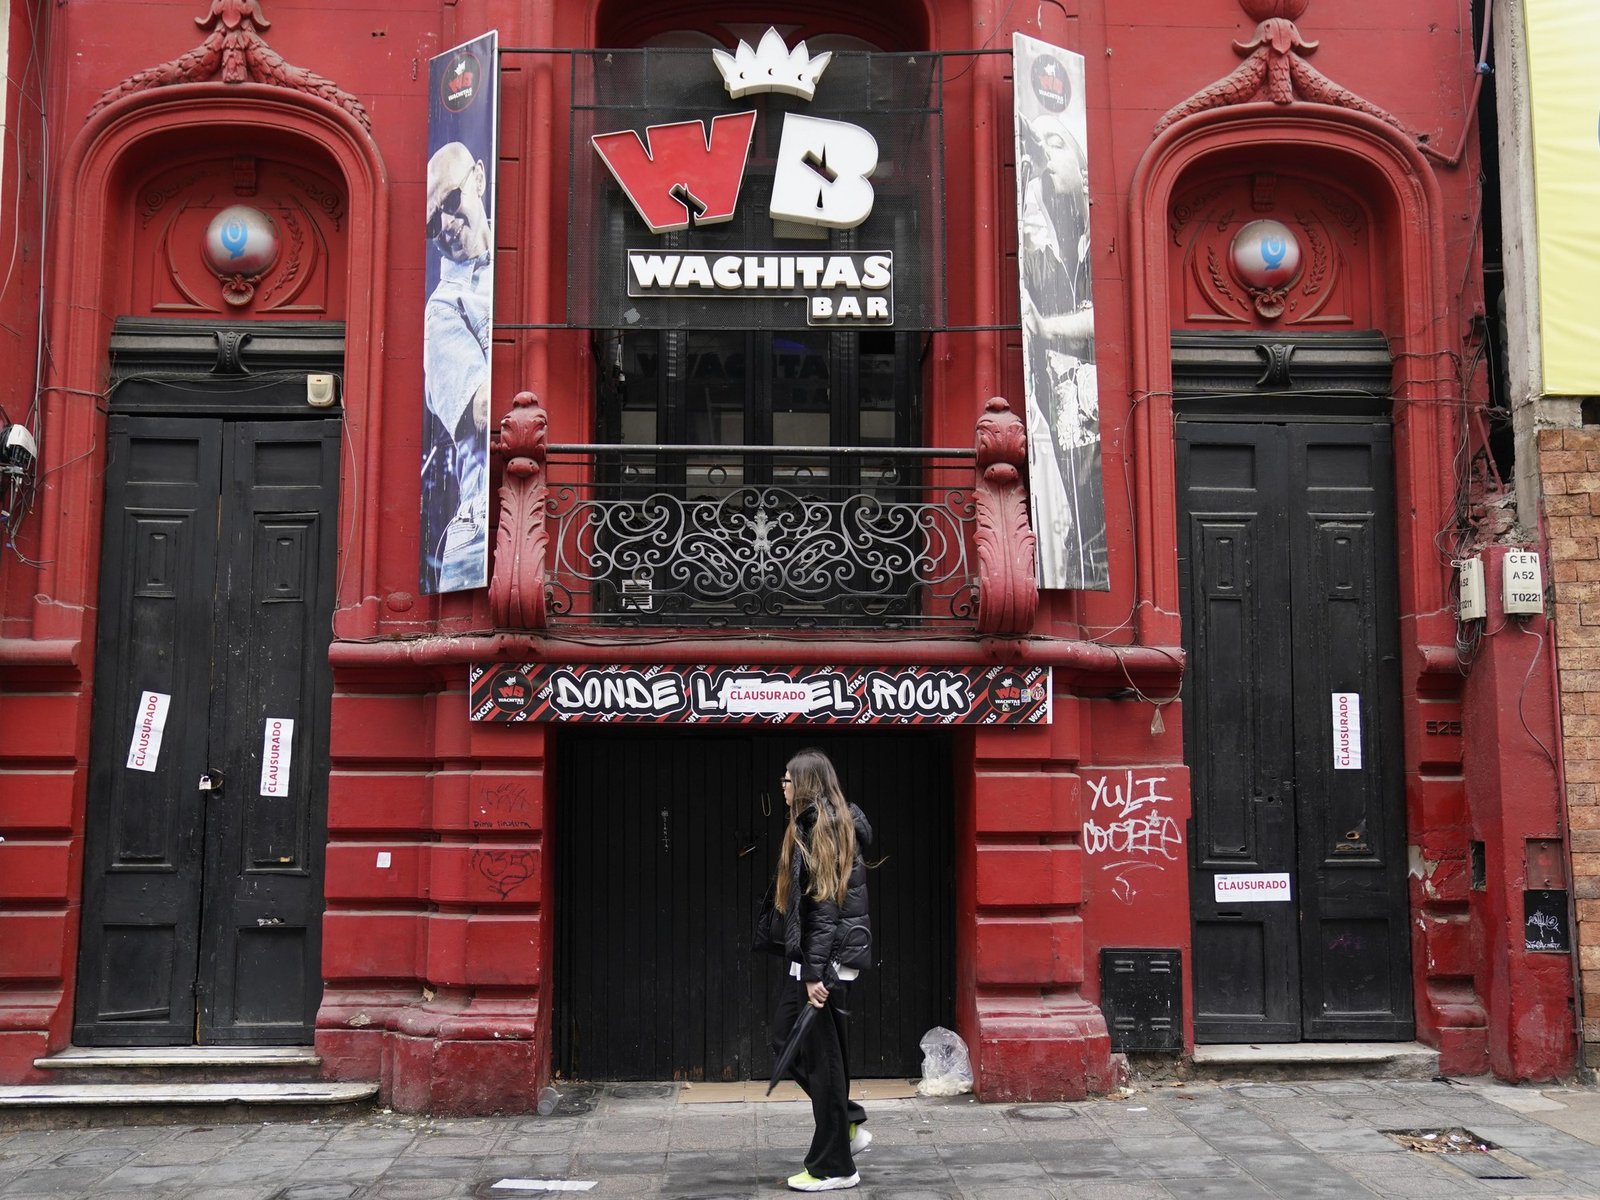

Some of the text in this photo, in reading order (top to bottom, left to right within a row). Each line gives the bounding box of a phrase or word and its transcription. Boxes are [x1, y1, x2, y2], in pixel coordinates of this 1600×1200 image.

[629, 255, 892, 289] WACHITAS
[812, 296, 888, 319] BAR
[1510, 555, 1537, 564] CEN
[1512, 571, 1534, 580] A52
[557, 677, 680, 710] DONDE
[872, 679, 964, 710] ROCK
[730, 690, 806, 701] CLAUSURADO
[135, 695, 158, 767] CLAUSURADO
[1339, 696, 1350, 766] CLAUSURADO
[267, 721, 282, 793] CLAUSURADO
[1217, 880, 1287, 890] CLAUSURADO
